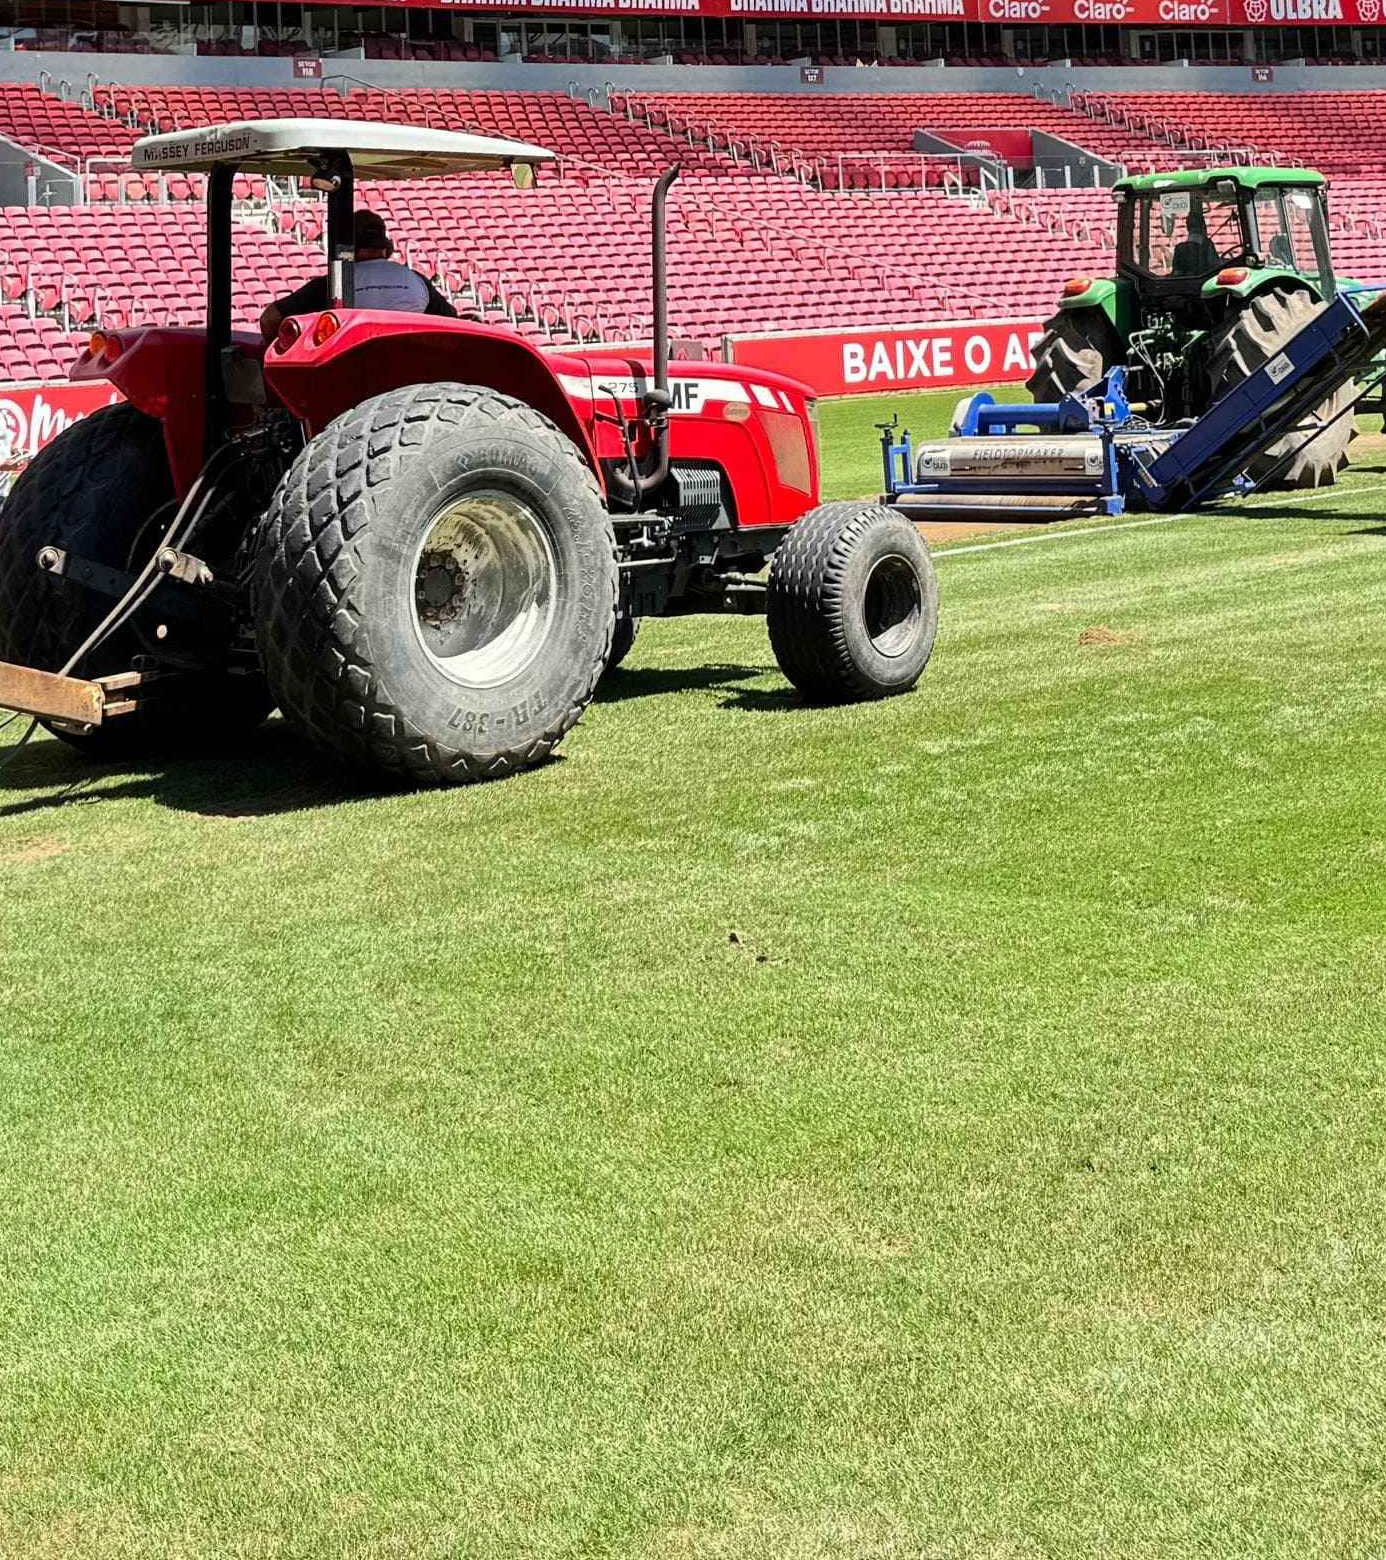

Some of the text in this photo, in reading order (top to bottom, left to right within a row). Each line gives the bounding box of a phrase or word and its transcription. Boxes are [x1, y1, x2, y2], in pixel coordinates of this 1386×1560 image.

[144, 135, 251, 162] MASSEY FERGUSON
[843, 337, 954, 384] BAIXE
[964, 335, 992, 374] O
